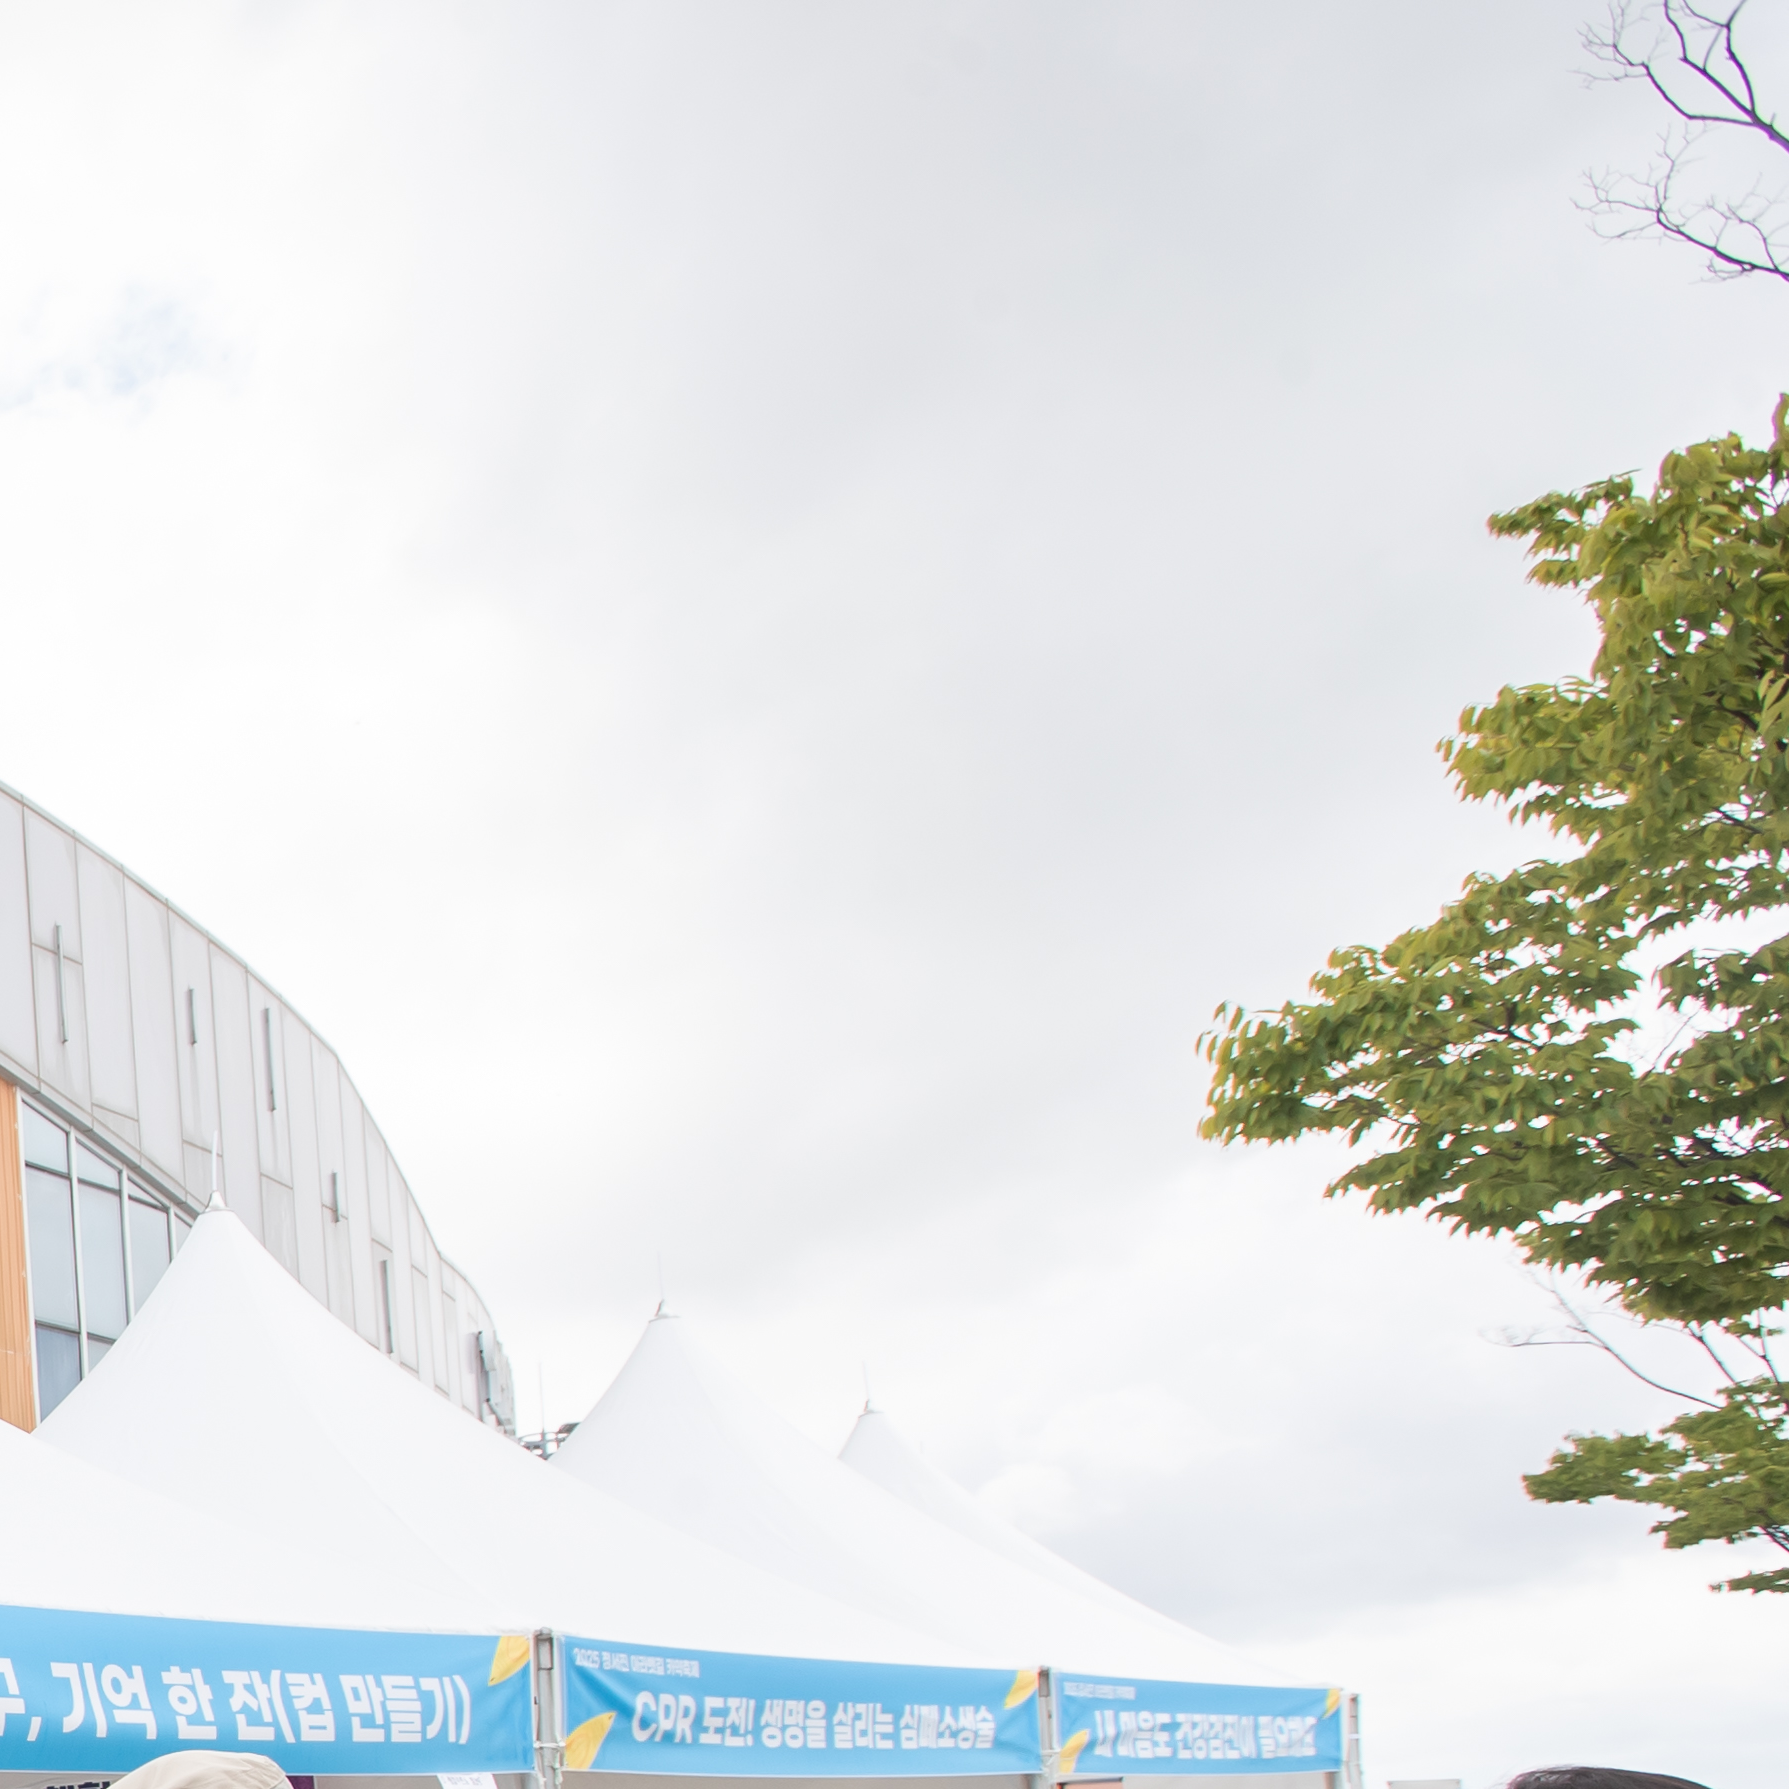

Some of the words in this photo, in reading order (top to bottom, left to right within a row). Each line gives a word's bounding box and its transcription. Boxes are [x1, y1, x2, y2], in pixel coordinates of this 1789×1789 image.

[50, 1657, 158, 1742] 기억
[162, 1665, 217, 1743] 한
[219, 1667, 336, 1746] 잔(컵
[342, 1671, 474, 1746] 만들기)
[631, 1690, 696, 1744] CPR
[698, 1696, 757, 1747] 도전!
[760, 1699, 827, 1749] 생명을
[832, 1701, 896, 1750] 살리는
[899, 1703, 997, 1750] 심폐소생술
